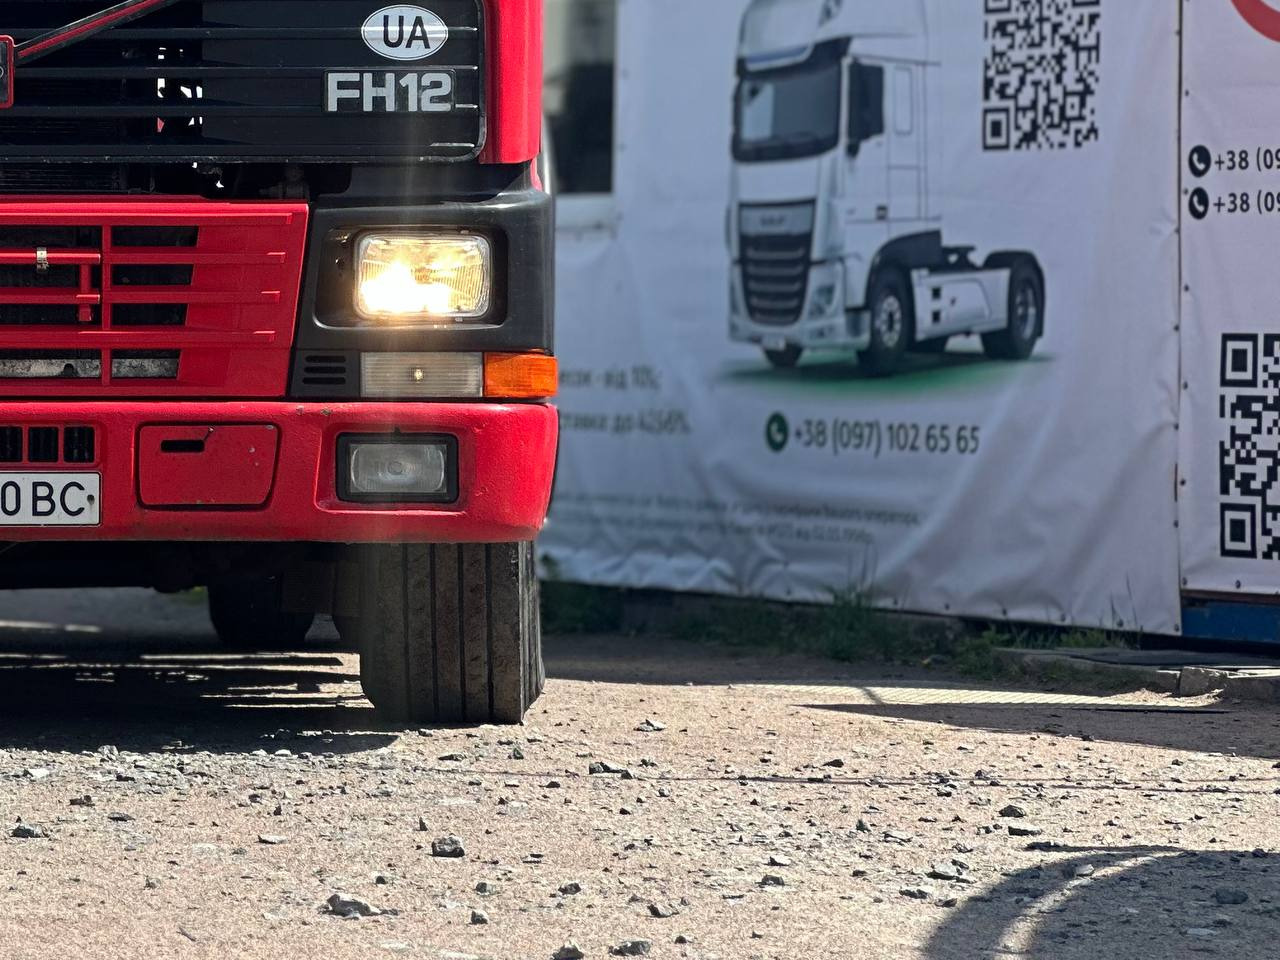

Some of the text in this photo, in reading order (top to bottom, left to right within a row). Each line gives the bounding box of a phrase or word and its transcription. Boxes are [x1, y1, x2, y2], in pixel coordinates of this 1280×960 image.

[382, 14, 431, 50] UA
[327, 72, 453, 112] FH12
[1214, 149, 1250, 171] +38
[1213, 192, 1250, 213] +38
[794, 416, 980, 459] +38 (097) 102 65 65
[31, 480, 86, 517] BC
